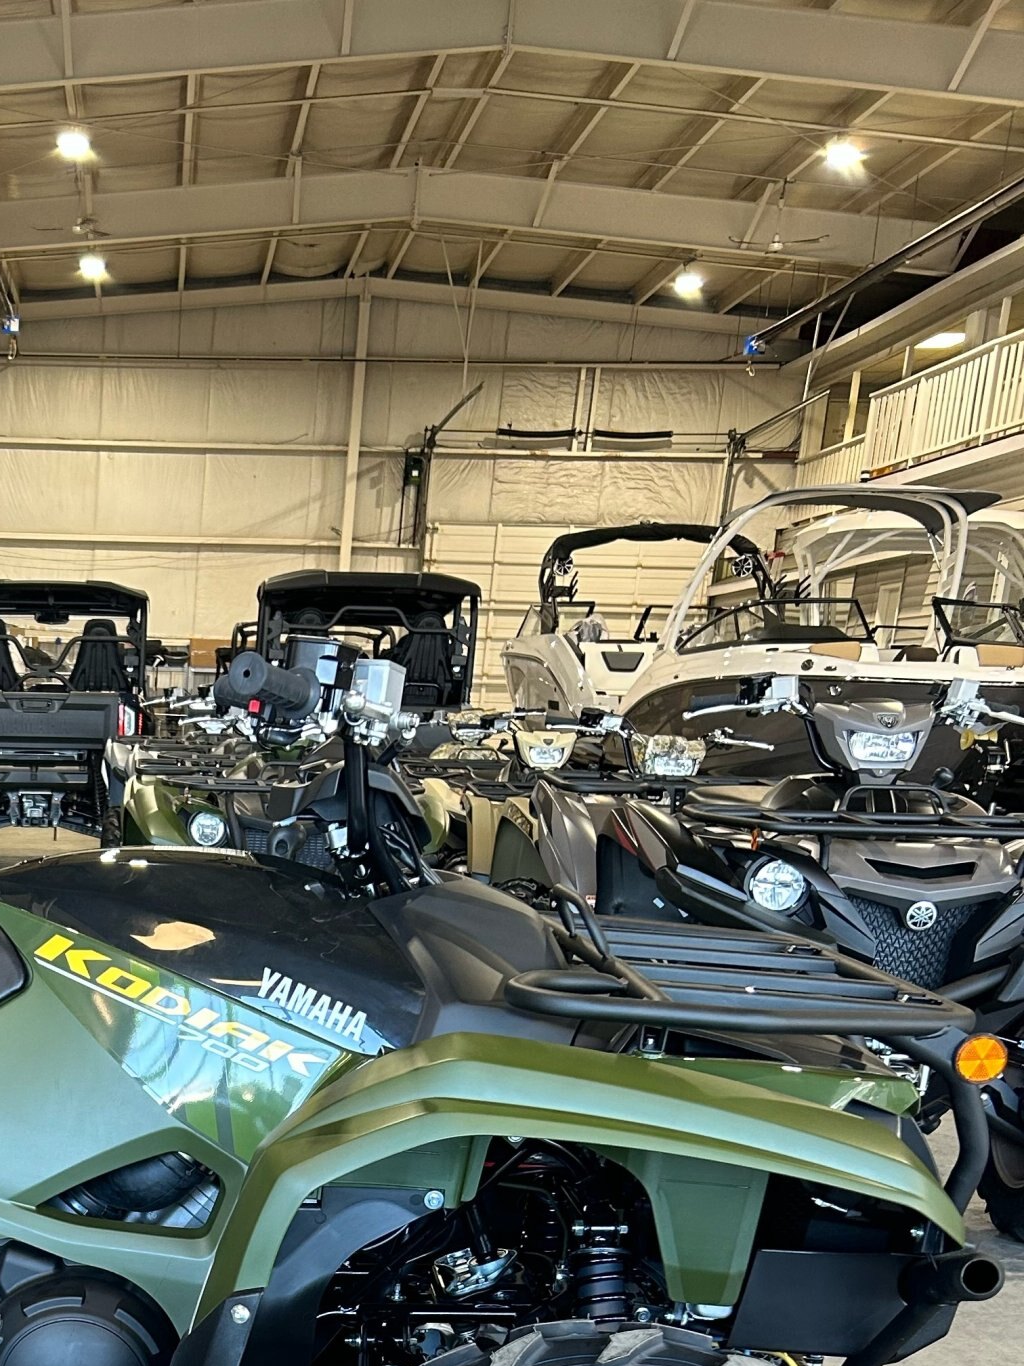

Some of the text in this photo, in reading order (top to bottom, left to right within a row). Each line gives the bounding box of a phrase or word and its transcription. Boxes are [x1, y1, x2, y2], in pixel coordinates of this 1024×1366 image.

[34, 934, 328, 1077] KODIAK
[256, 966, 368, 1042] YAMAHA
[176, 1023, 271, 1073] 700
